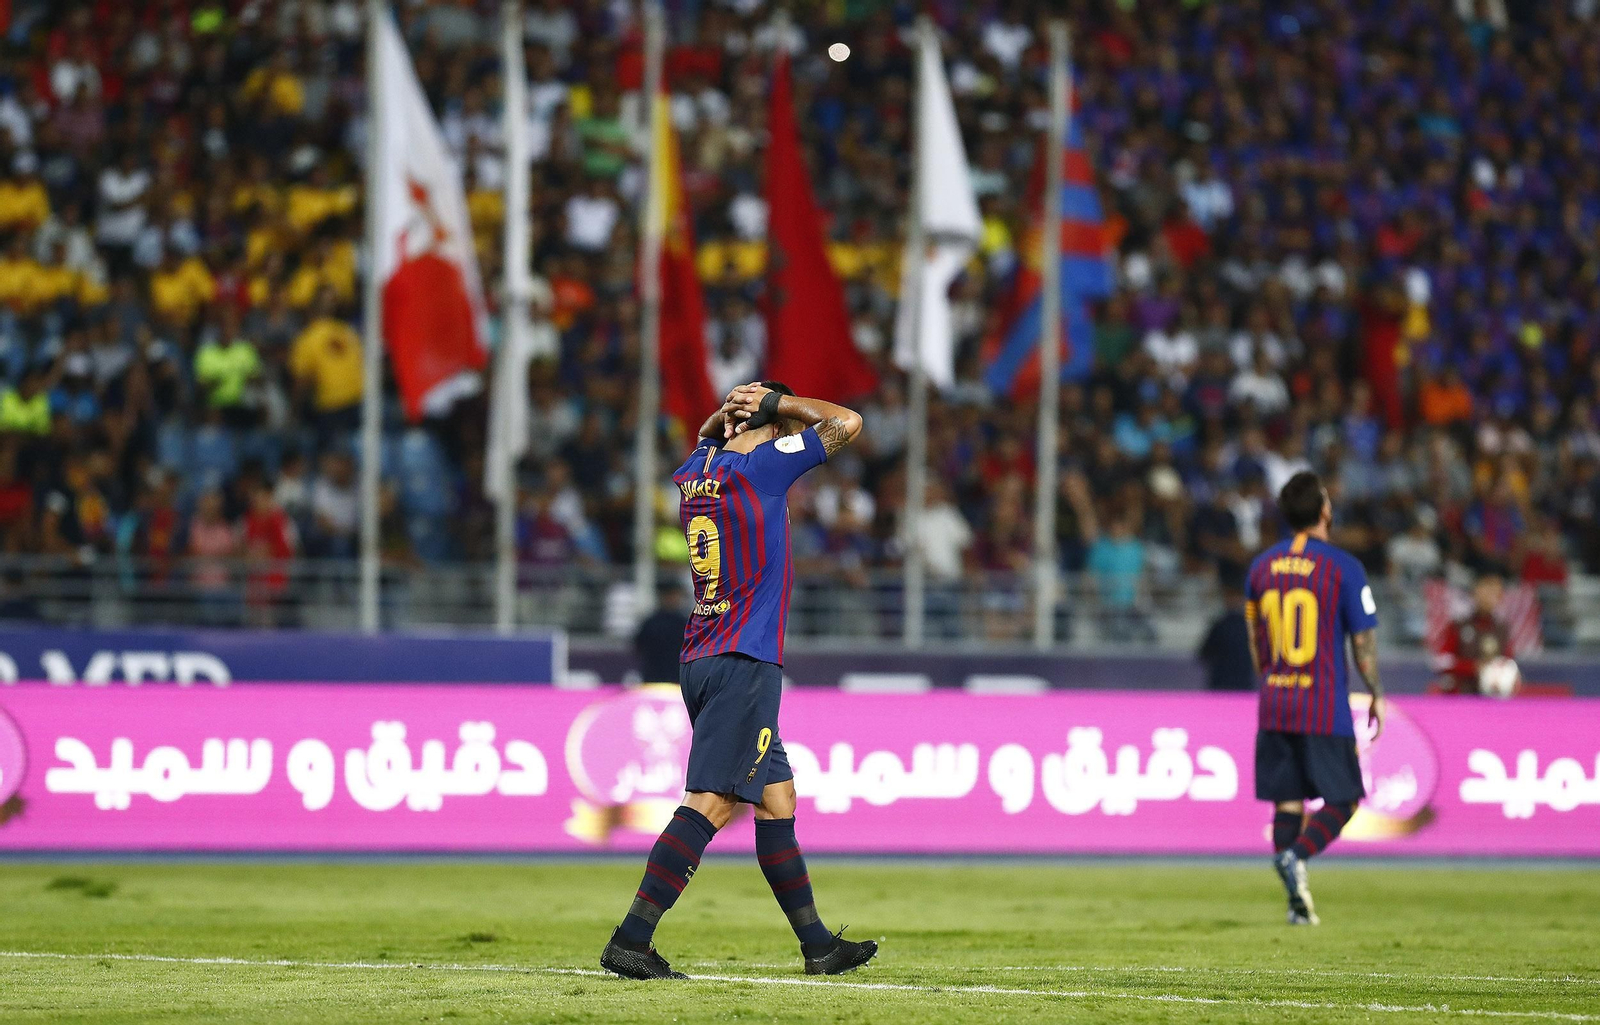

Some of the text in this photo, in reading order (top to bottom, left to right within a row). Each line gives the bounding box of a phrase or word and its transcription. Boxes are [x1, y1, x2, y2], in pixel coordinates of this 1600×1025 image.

[687, 515, 720, 600] 9
[1260, 587, 1318, 667] 10
[45, 738, 273, 810] سميد
[286, 739, 335, 810] و
[344, 721, 548, 811] دقيق
[756, 727, 772, 764] 9
[988, 744, 1035, 813] و
[1041, 726, 1238, 815] دقيق
[1459, 749, 1600, 818] ميد
